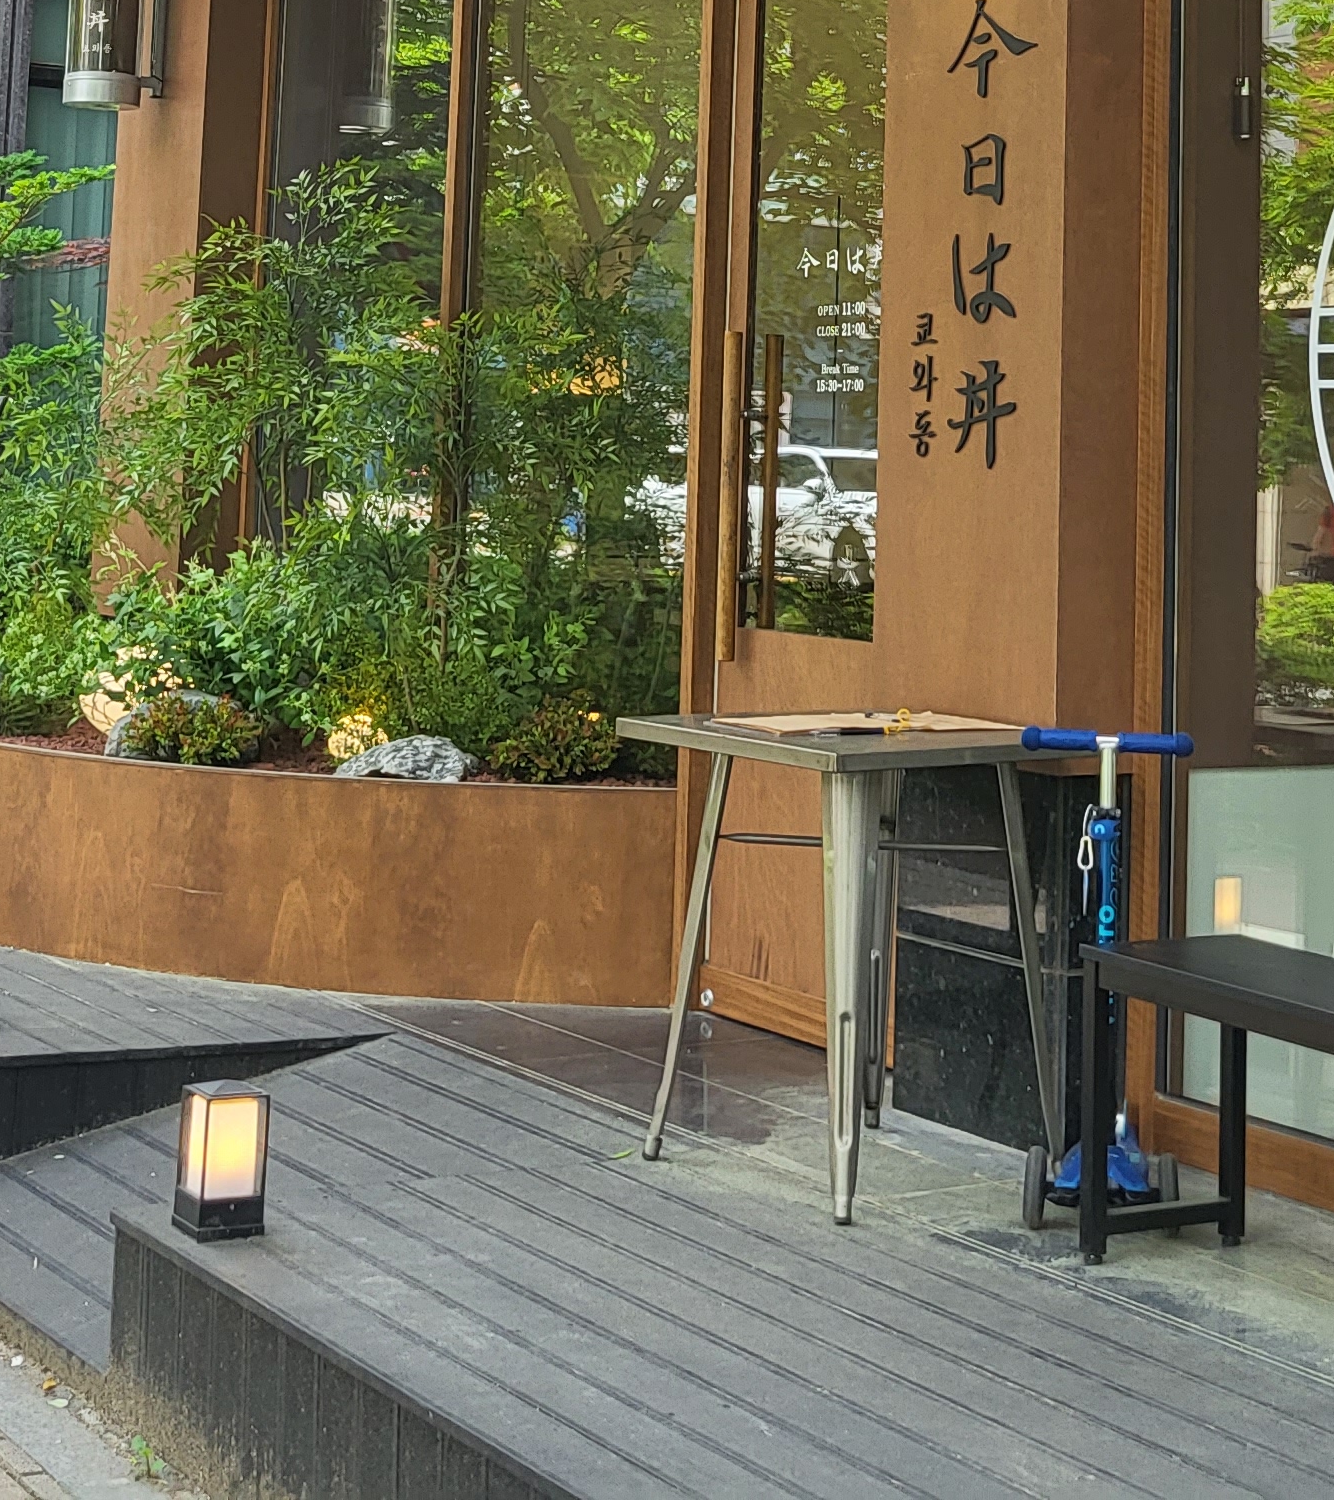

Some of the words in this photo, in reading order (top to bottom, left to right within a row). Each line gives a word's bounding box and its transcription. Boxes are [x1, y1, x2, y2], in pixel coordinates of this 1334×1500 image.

[817, 304, 840, 317] OPEN
[842, 301, 866, 316] 11:00
[816, 325, 840, 337] CLOSE
[841, 322, 866, 337] 21:00
[821, 363, 841, 375] Break
[842, 363, 860, 374] Time
[909, 312, 939, 457] 쿄와동
